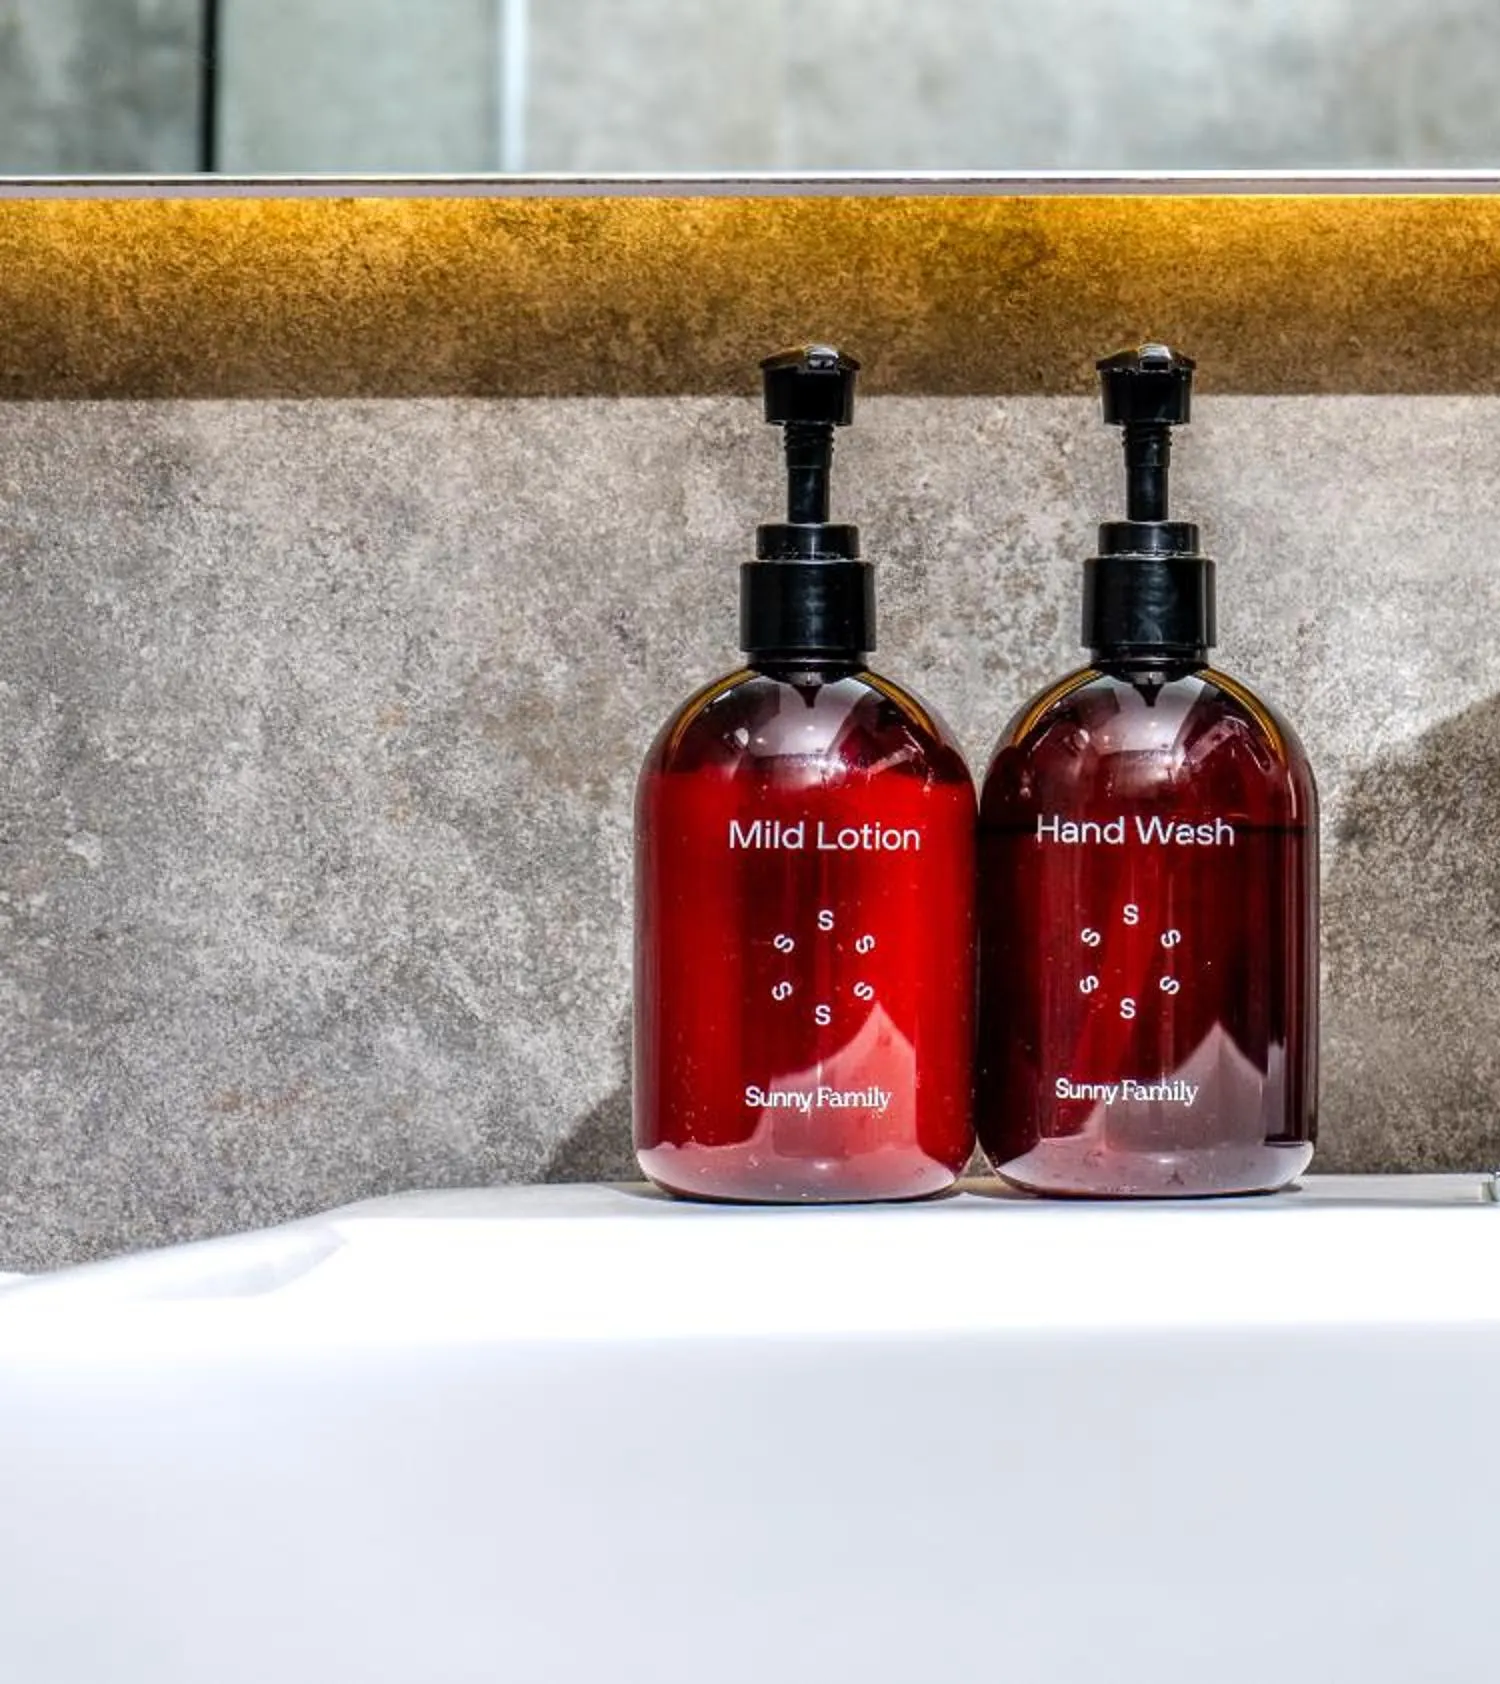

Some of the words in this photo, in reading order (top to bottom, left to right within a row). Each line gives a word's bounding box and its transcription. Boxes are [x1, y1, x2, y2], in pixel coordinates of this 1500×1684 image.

[729, 819, 805, 850] Mild
[816, 820, 921, 851] Lotion
[1036, 813, 1125, 845] Hand
[1134, 815, 1235, 847] Wash
[745, 1085, 812, 1112] Sunny
[816, 1086, 891, 1112] Family
[1055, 1077, 1118, 1104] Sunny
[1121, 1079, 1199, 1107] Family
